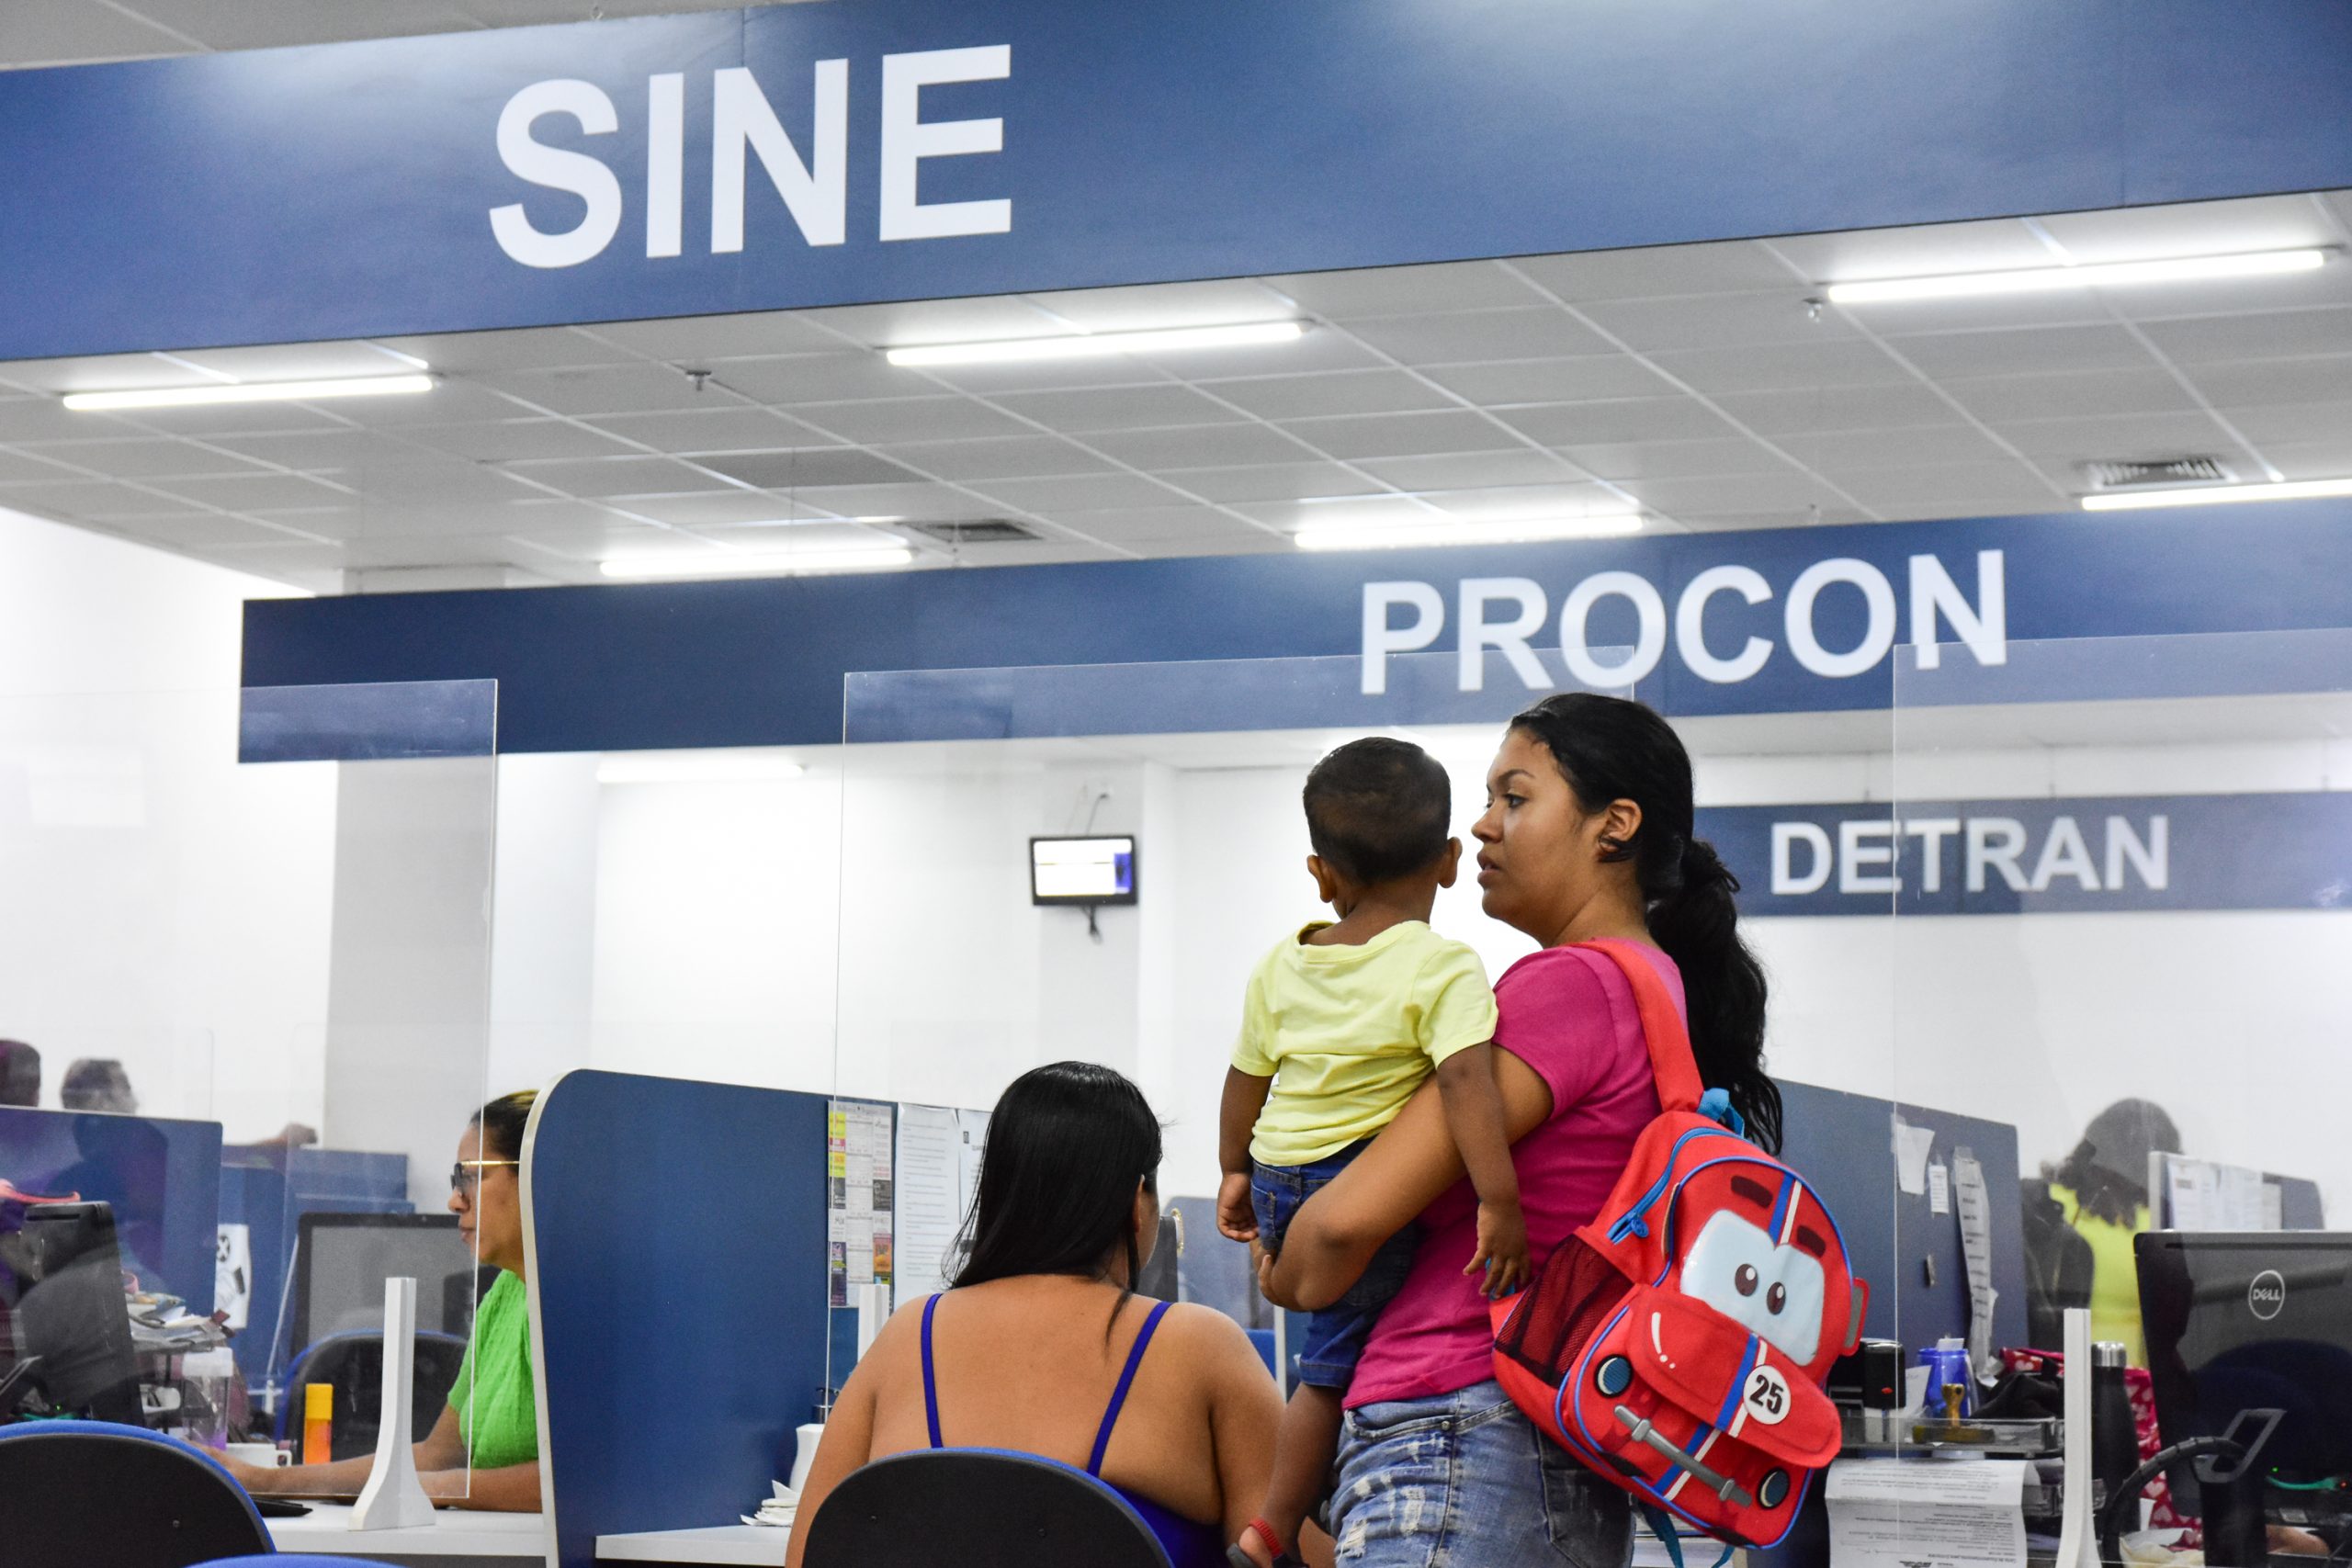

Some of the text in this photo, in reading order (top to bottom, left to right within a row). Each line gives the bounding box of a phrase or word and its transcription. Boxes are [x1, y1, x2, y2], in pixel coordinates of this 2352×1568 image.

[489, 44, 1011, 268] SINE
[1361, 549, 2007, 694] PROCON
[1771, 815, 2168, 895] DETRAN
[2253, 1288, 2280, 1301] DELL
[1749, 1374, 1784, 1415] 25
